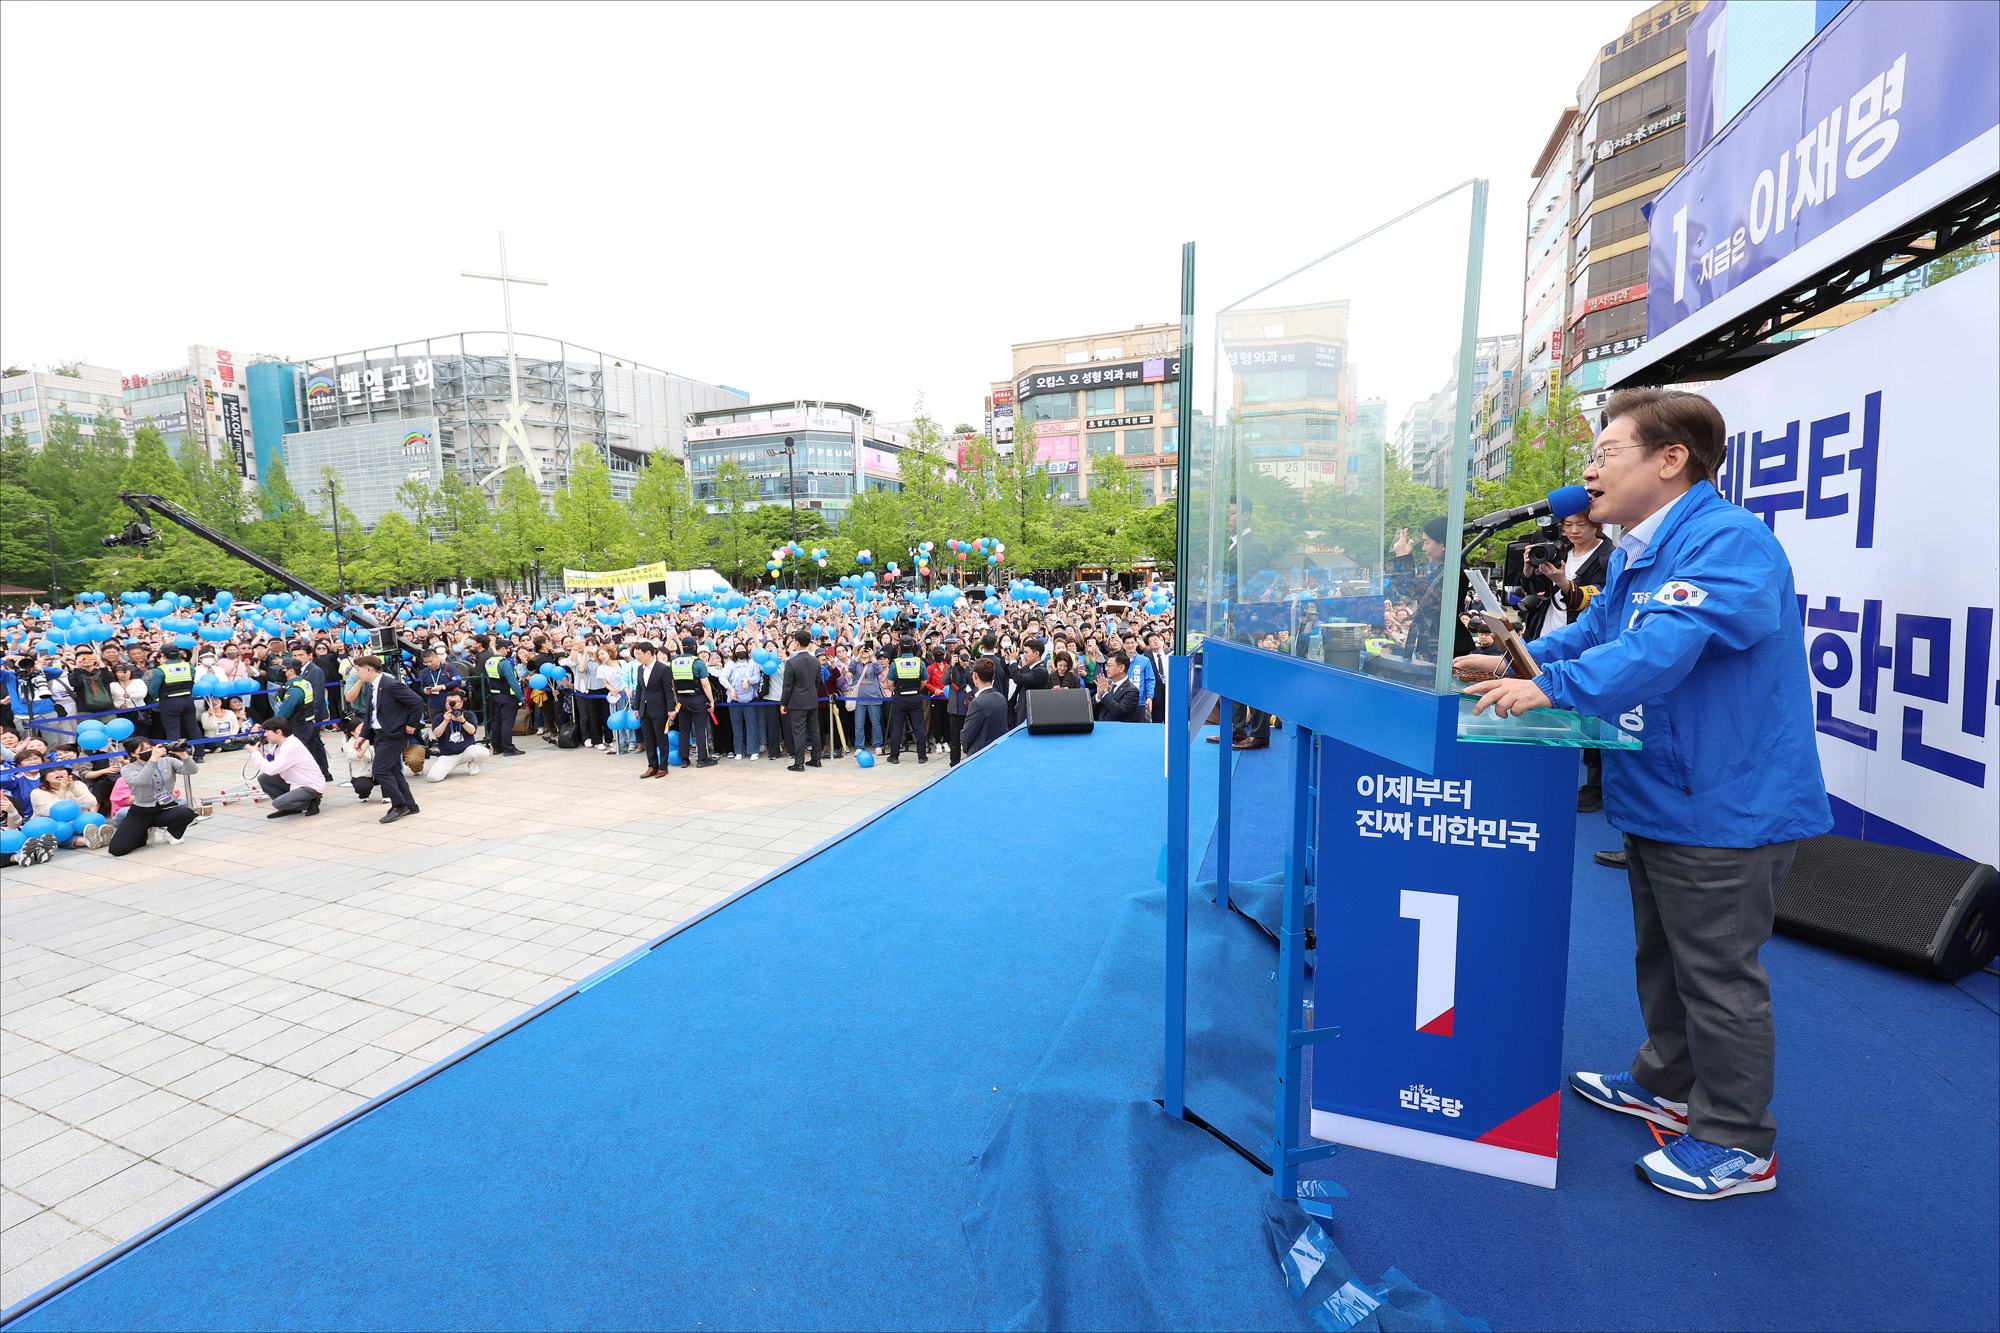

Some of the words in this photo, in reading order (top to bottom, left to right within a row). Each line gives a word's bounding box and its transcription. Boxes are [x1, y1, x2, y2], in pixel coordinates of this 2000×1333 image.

[1605, 2, 1692, 56] 메트로골드
[1699, 226, 1746, 285] 지금은
[1750, 52, 1907, 245] 이재명
[1672, 204, 1688, 304] 1
[1280, 353, 1295, 363] 의원
[808, 448, 852, 458] PPEUM
[1285, 463, 1299, 474] 25
[1795, 594, 2000, 789] 한민
[1356, 774, 1473, 810] 이제부터
[1355, 810, 1414, 841] 진짜
[1418, 814, 1541, 853] 대한민국
[1400, 889, 1459, 1037] 1
[1400, 1089, 1464, 1118] 민주당
[1409, 1083, 1433, 1095] 더불어
